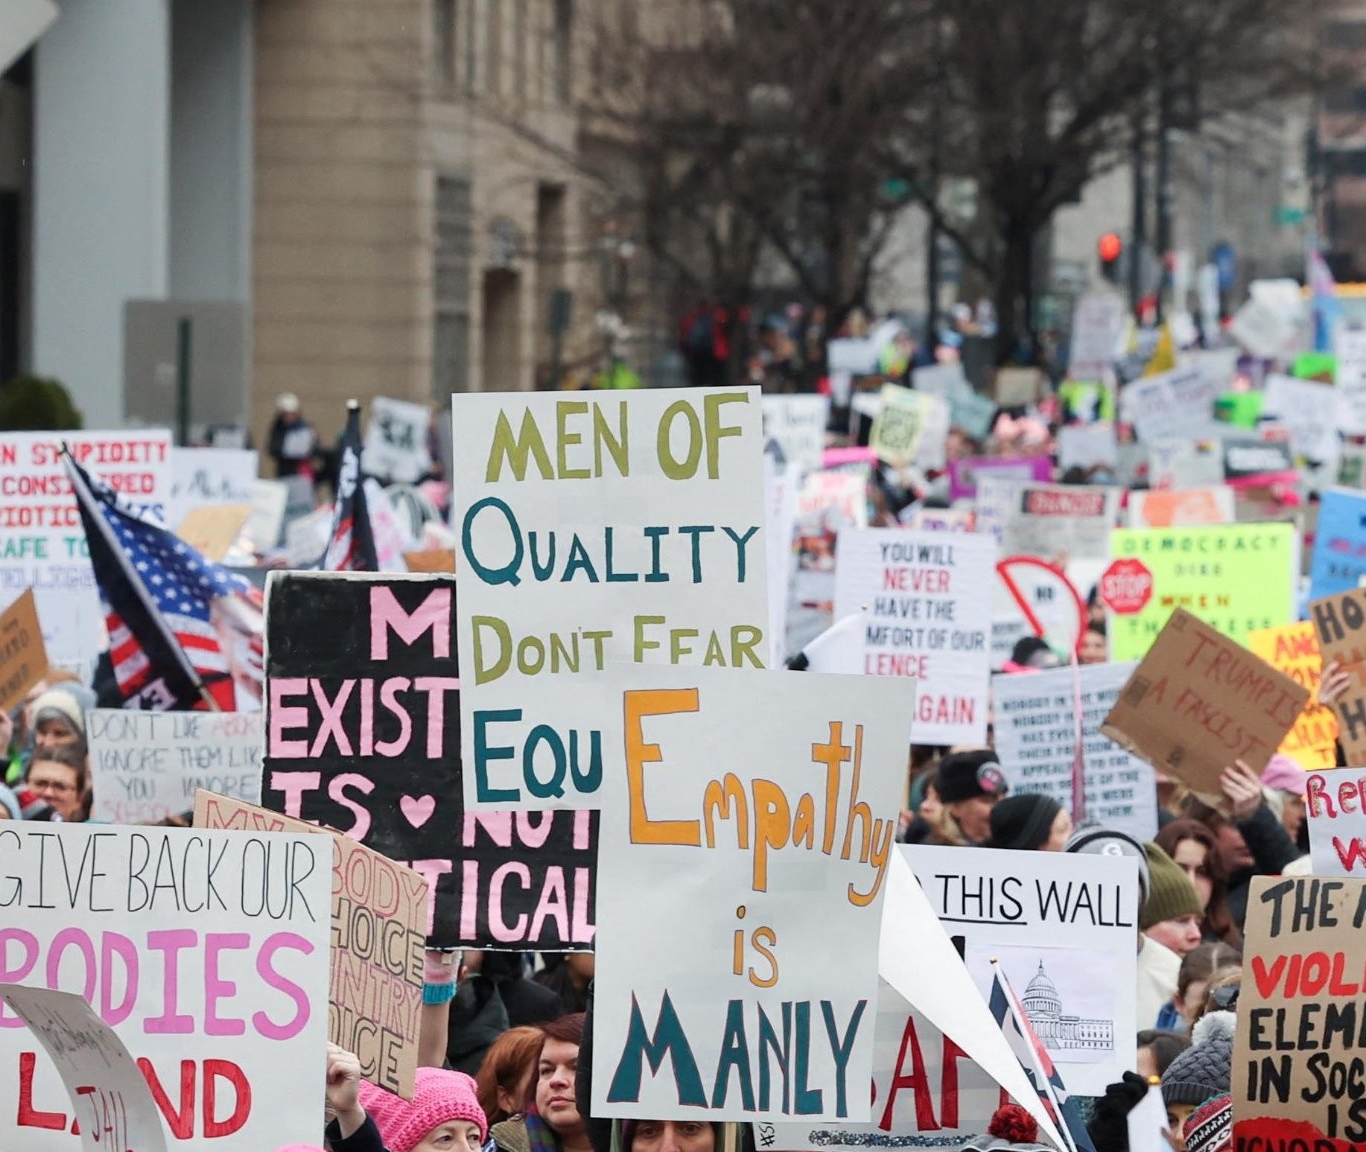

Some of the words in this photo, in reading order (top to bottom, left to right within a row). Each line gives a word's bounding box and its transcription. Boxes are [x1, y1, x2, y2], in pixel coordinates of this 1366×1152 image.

[485, 400, 629, 483] MEN
[657, 392, 750, 480] OF
[462, 497, 761, 587] QUALITY
[880, 543, 914, 563] YOU
[918, 545, 955, 566] WILL
[874, 597, 921, 619] HAVE
[925, 600, 956, 621] THE
[884, 568, 950, 593] NEVER
[473, 614, 613, 686] DON'T
[928, 627, 948, 649] OF
[952, 630, 985, 650] OUR
[1183, 631, 1273, 704] TRUMP
[918, 695, 975, 725] GAIN
[1175, 690, 1267, 758] FASCIST
[623, 687, 894, 908] Empathy
[127, 832, 229, 912] BACK
[240, 838, 317, 922] OUR
[936, 873, 1024, 921] THIS
[1036, 876, 1132, 928] WALL
[1260, 879, 1344, 938] THE
[732, 905, 779, 988] is
[606, 988, 868, 1119] MANLY
[1246, 1054, 1292, 1103] IN
[16, 1051, 252, 1141] LND
